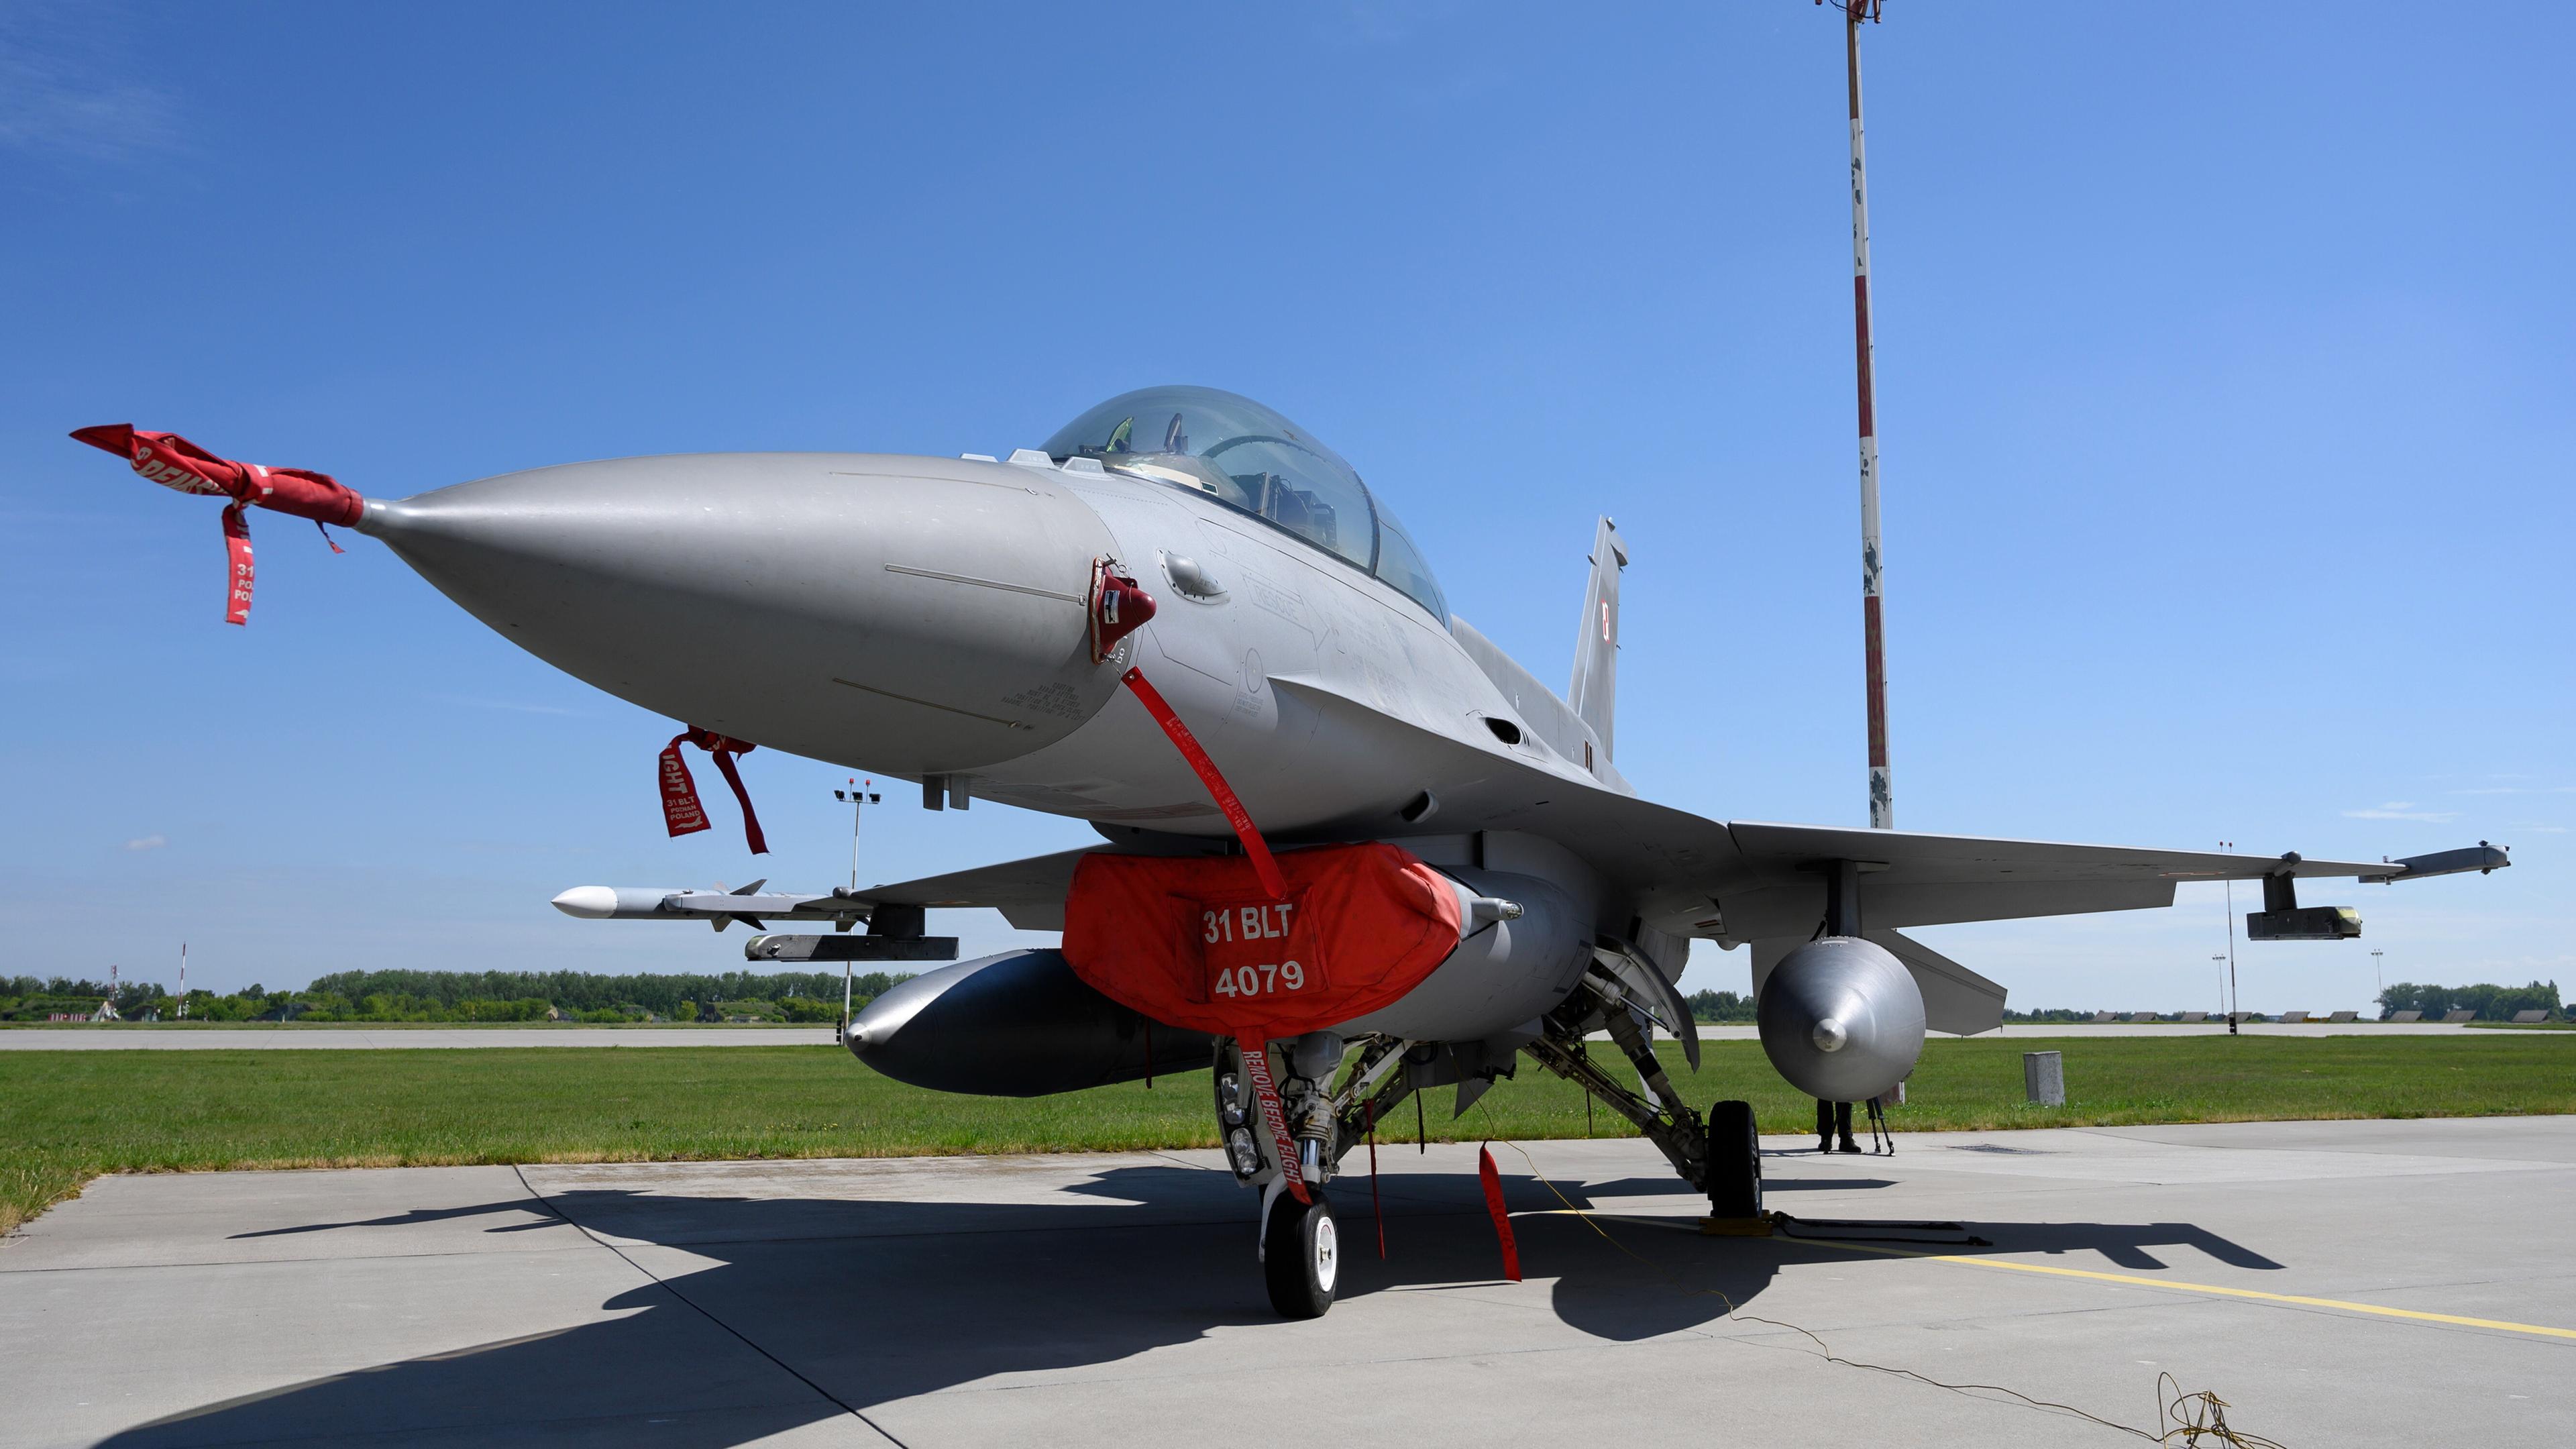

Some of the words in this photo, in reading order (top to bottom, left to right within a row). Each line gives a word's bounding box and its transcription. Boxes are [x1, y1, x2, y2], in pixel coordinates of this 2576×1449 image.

[237, 564, 254, 577] 31
[238, 579, 254, 590] PO
[662, 745, 688, 794] IGHT
[678, 796, 695, 806] BLT
[670, 810, 700, 820] POLAND
[1203, 909, 1232, 944] 31
[1241, 904, 1293, 940] BLT
[1215, 961, 1304, 998] 4079
[1242, 1051, 1277, 1097] REMOVE
[1260, 1094, 1291, 1142] BEFORE
[1277, 1140, 1302, 1185] FLIGHT
